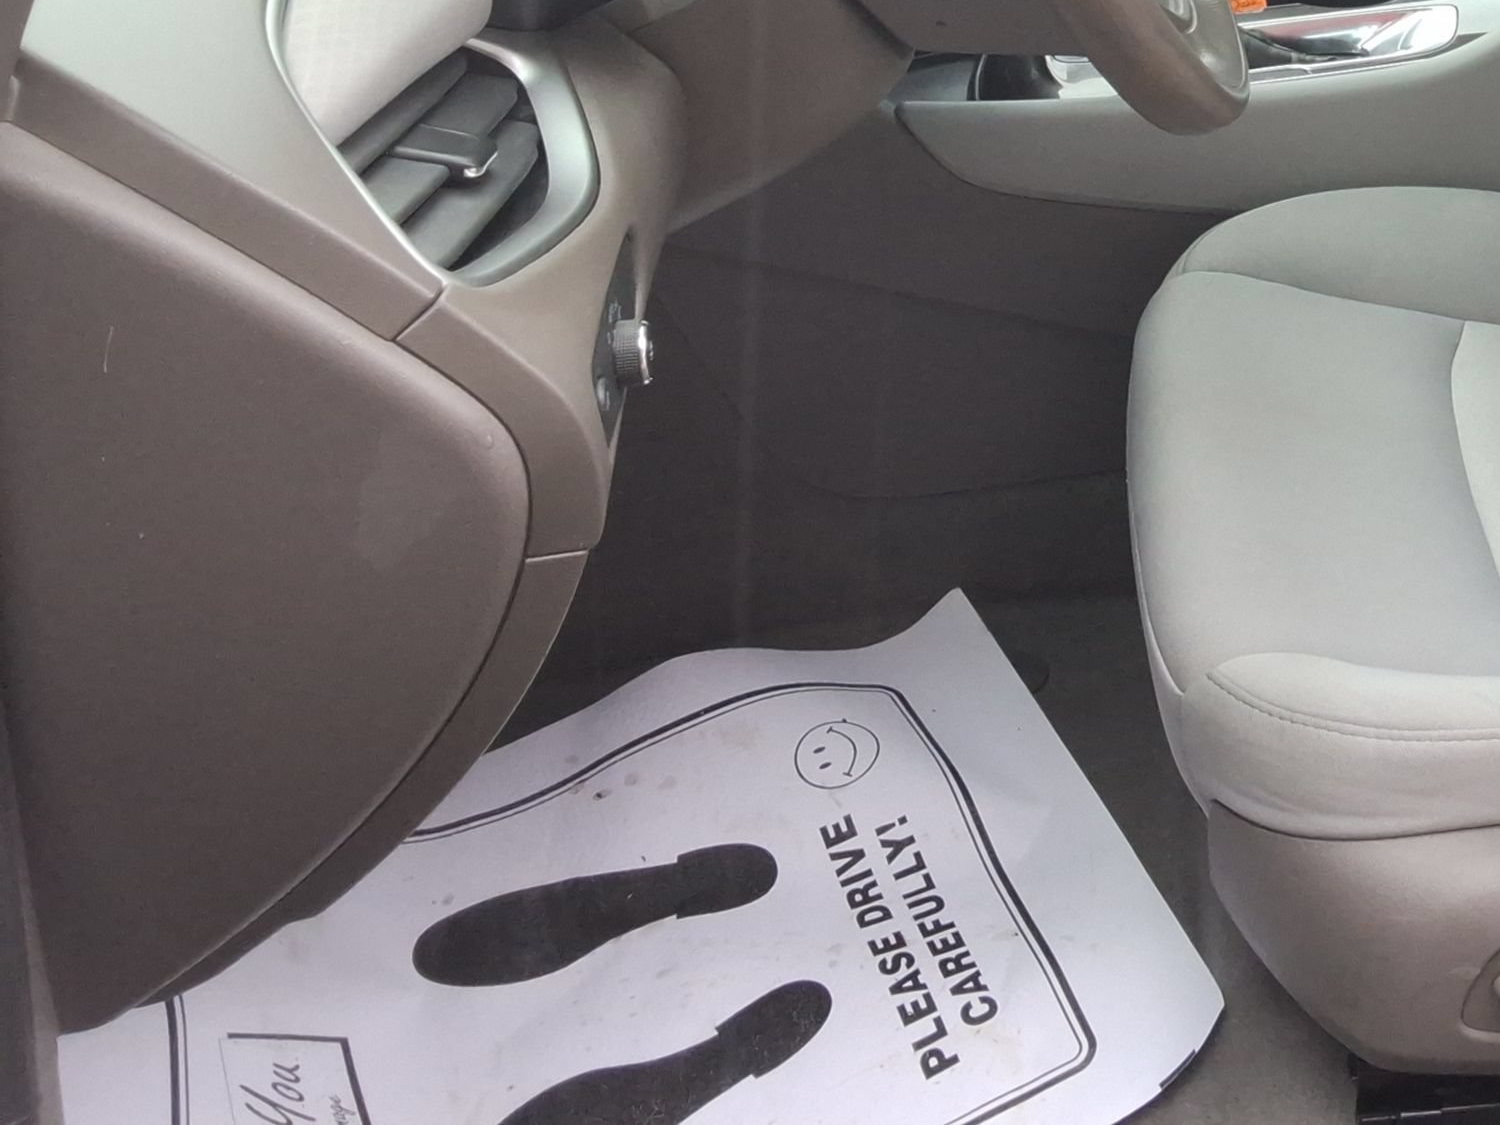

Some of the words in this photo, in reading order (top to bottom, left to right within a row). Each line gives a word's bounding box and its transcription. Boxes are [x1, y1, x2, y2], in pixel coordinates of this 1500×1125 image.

[819, 814, 893, 928] DRIVE
[875, 814, 998, 1025] CAREFULLY!
[866, 931, 960, 1080] PLEASE
